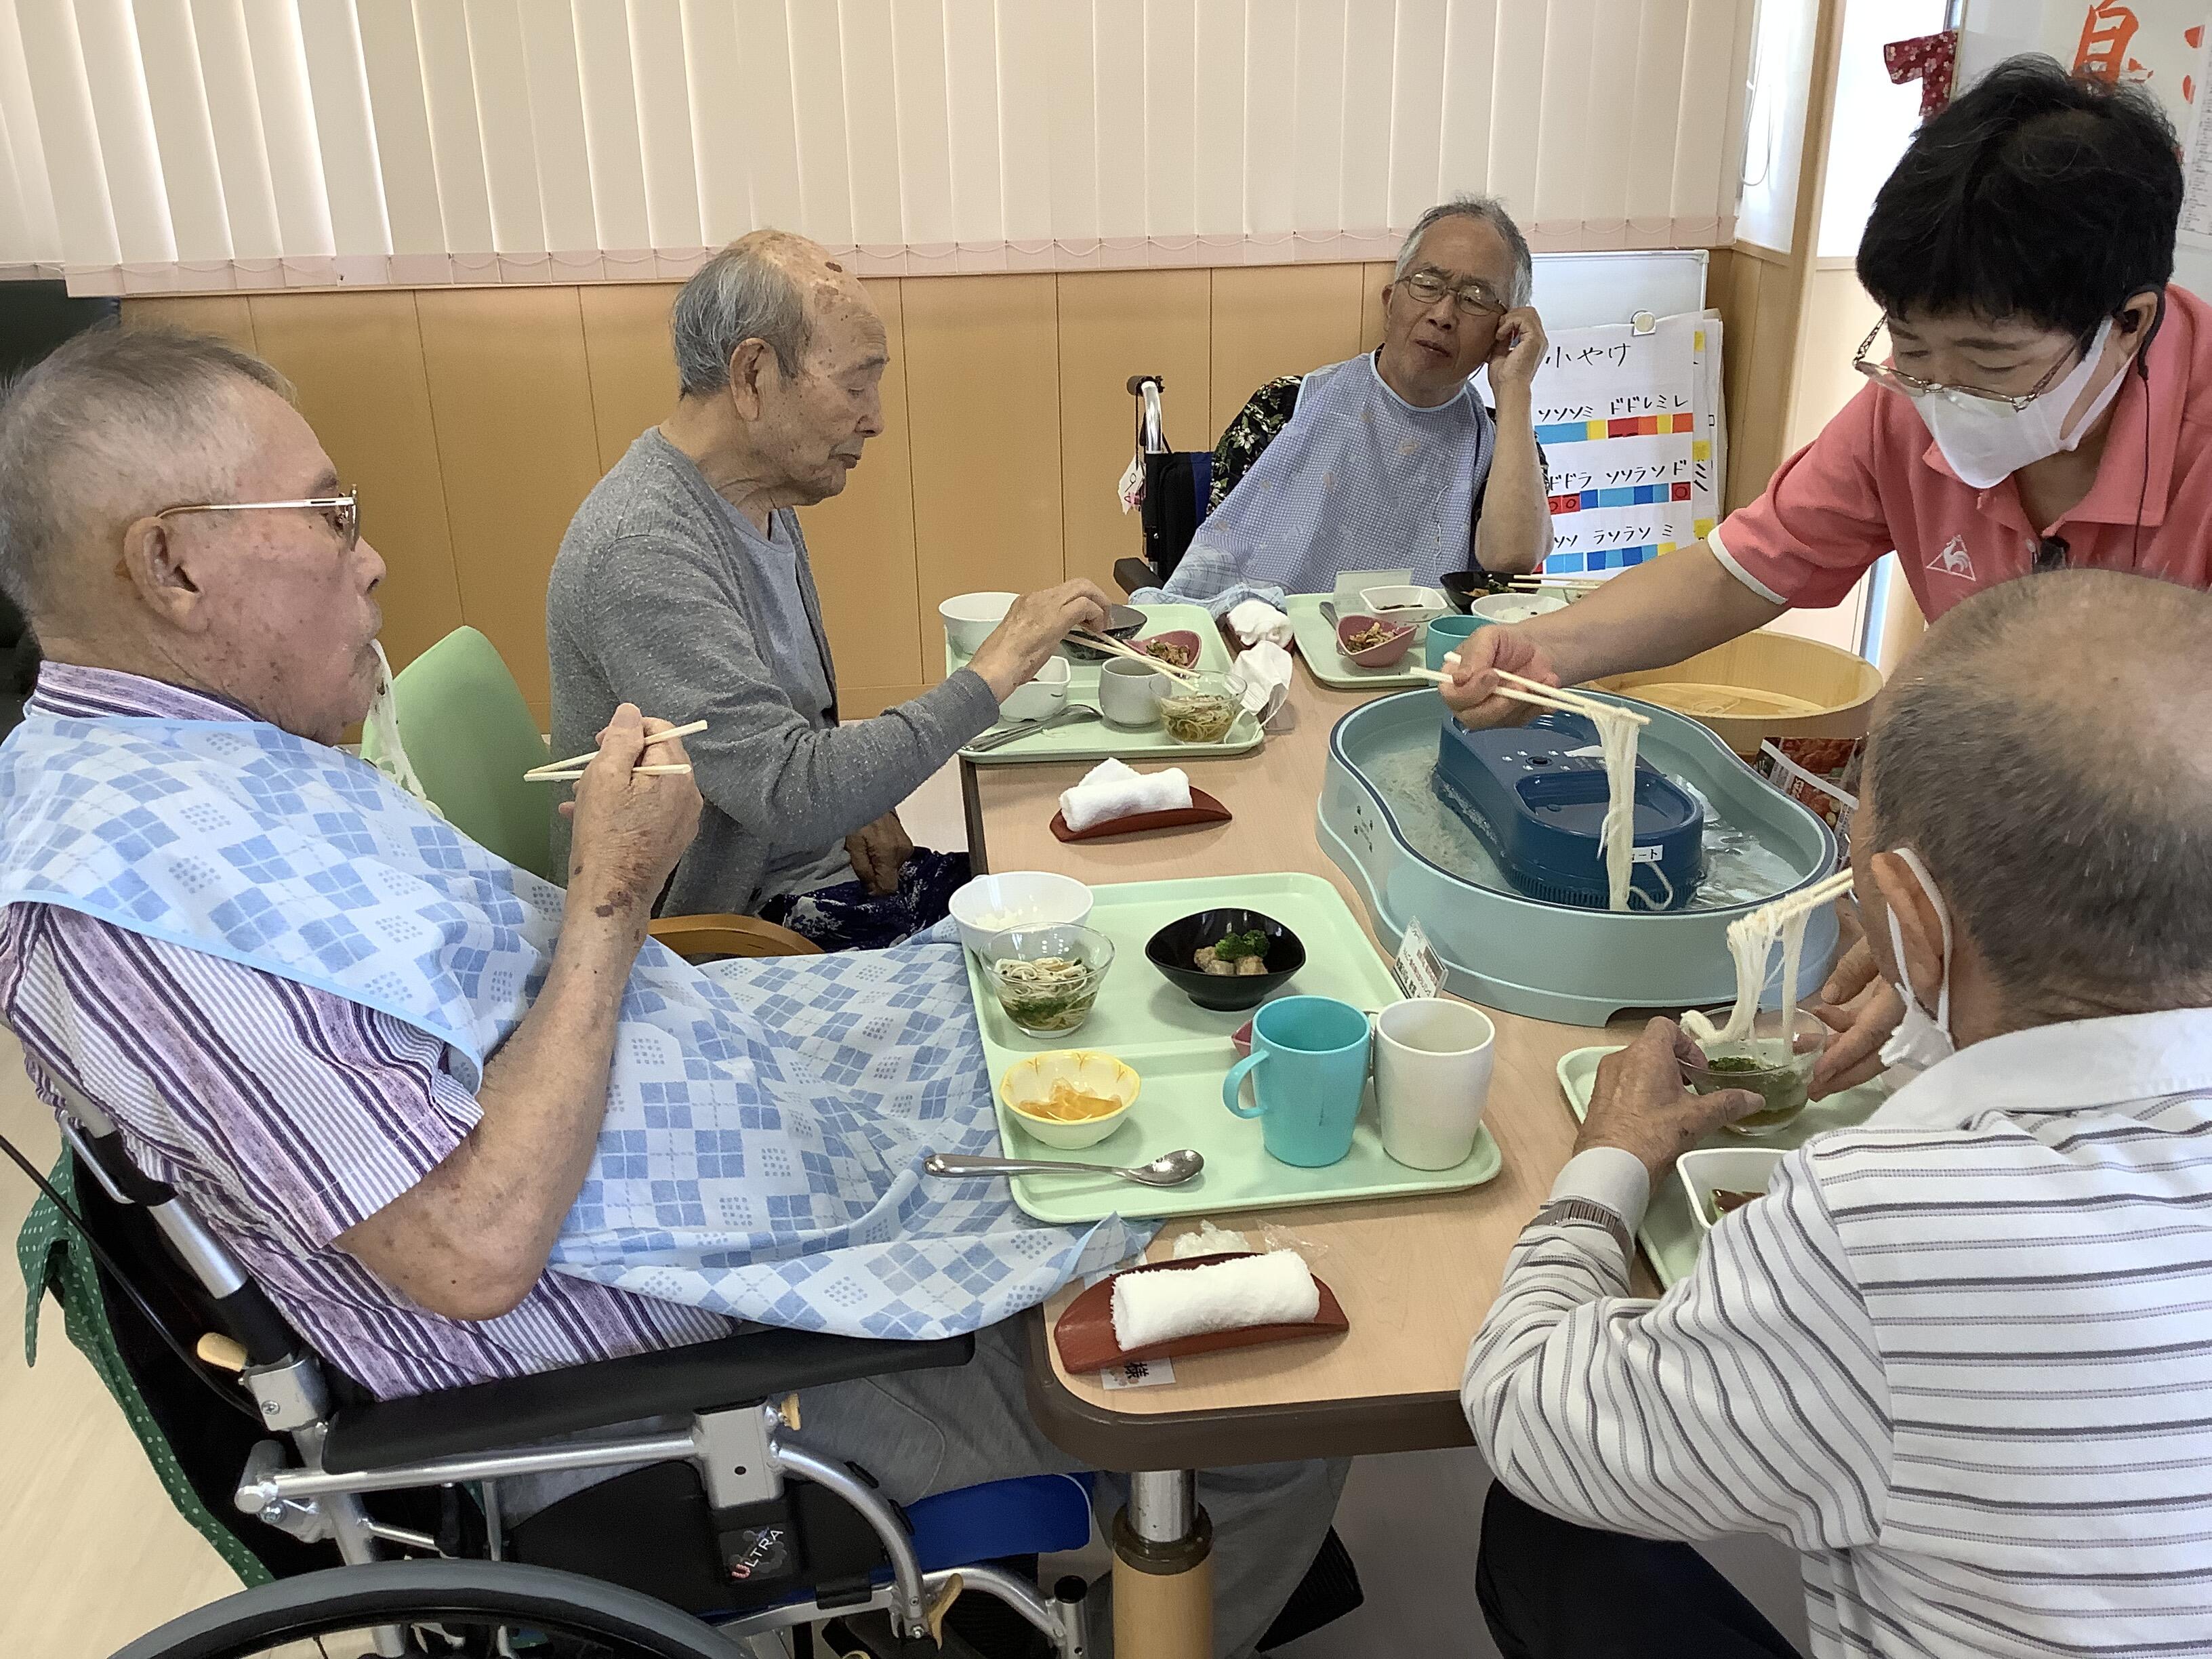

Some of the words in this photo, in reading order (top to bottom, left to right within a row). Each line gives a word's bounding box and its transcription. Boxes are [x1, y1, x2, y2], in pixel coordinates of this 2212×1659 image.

[1545, 343, 1631, 368] 小やけ
[731, 1529, 784, 1579] ULTRA
